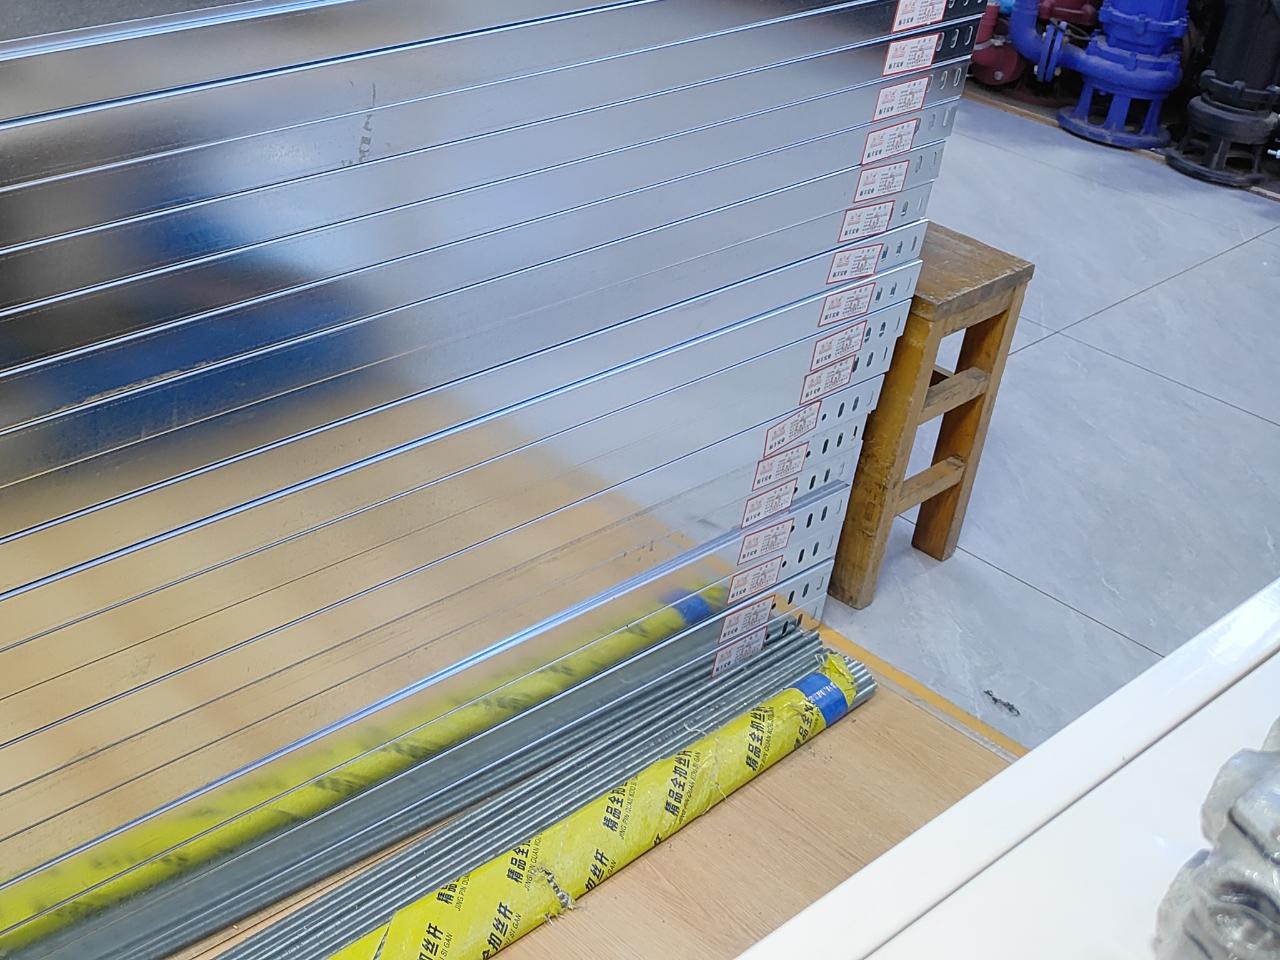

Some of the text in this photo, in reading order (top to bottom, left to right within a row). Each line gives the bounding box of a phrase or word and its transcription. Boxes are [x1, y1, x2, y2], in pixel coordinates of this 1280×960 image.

[603, 782, 627, 831] 精品全扣
[506, 840, 531, 883] 精品全
[436, 877, 459, 904] 精品
